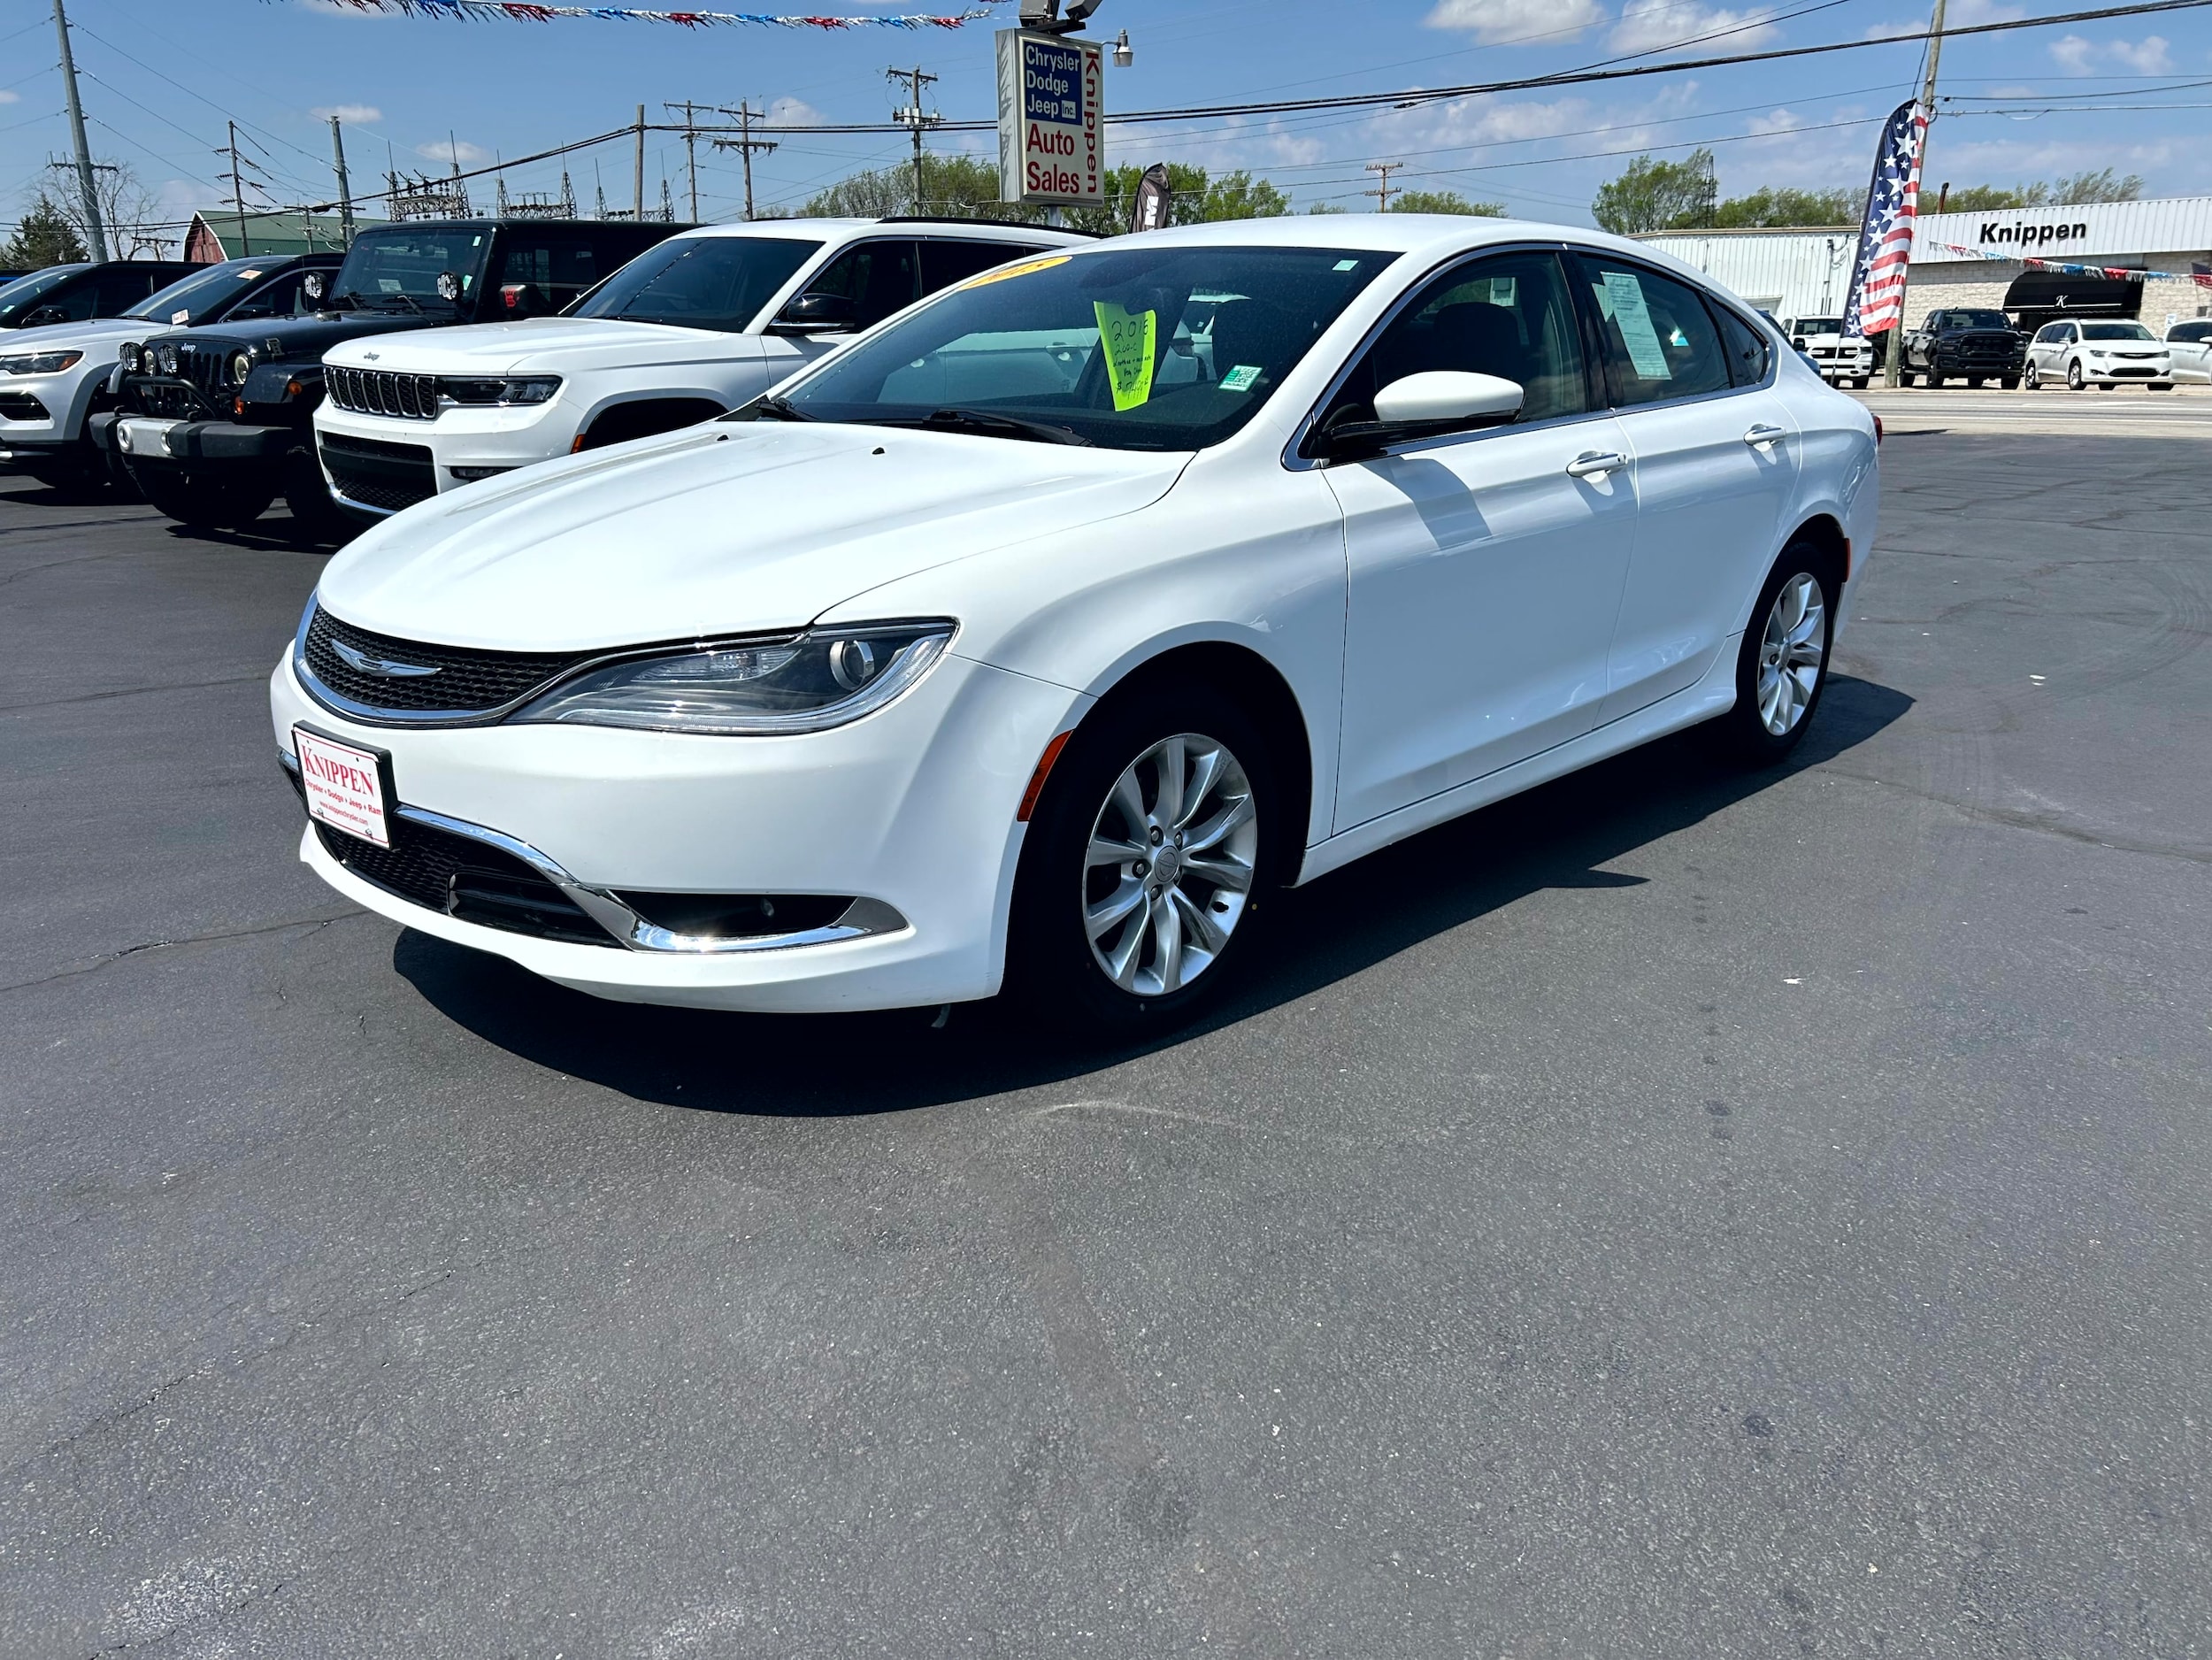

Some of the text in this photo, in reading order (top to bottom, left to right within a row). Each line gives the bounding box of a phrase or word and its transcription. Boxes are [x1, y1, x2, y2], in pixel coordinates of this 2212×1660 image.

[1025, 45, 1079, 72] Chrysler
[1026, 70, 1069, 96] Dodge
[1027, 94, 1076, 119] Jeep Inc.
[1084, 51, 1100, 193] Knippen
[1026, 123, 1075, 156] Auto
[1027, 161, 1079, 194] Sales
[1979, 221, 2086, 248] Knippen
[1111, 319, 1148, 342] 2016
[301, 744, 374, 796] KNIPPEN
[349, 797, 363, 811] Jeep
[368, 803, 382, 816] Ram
